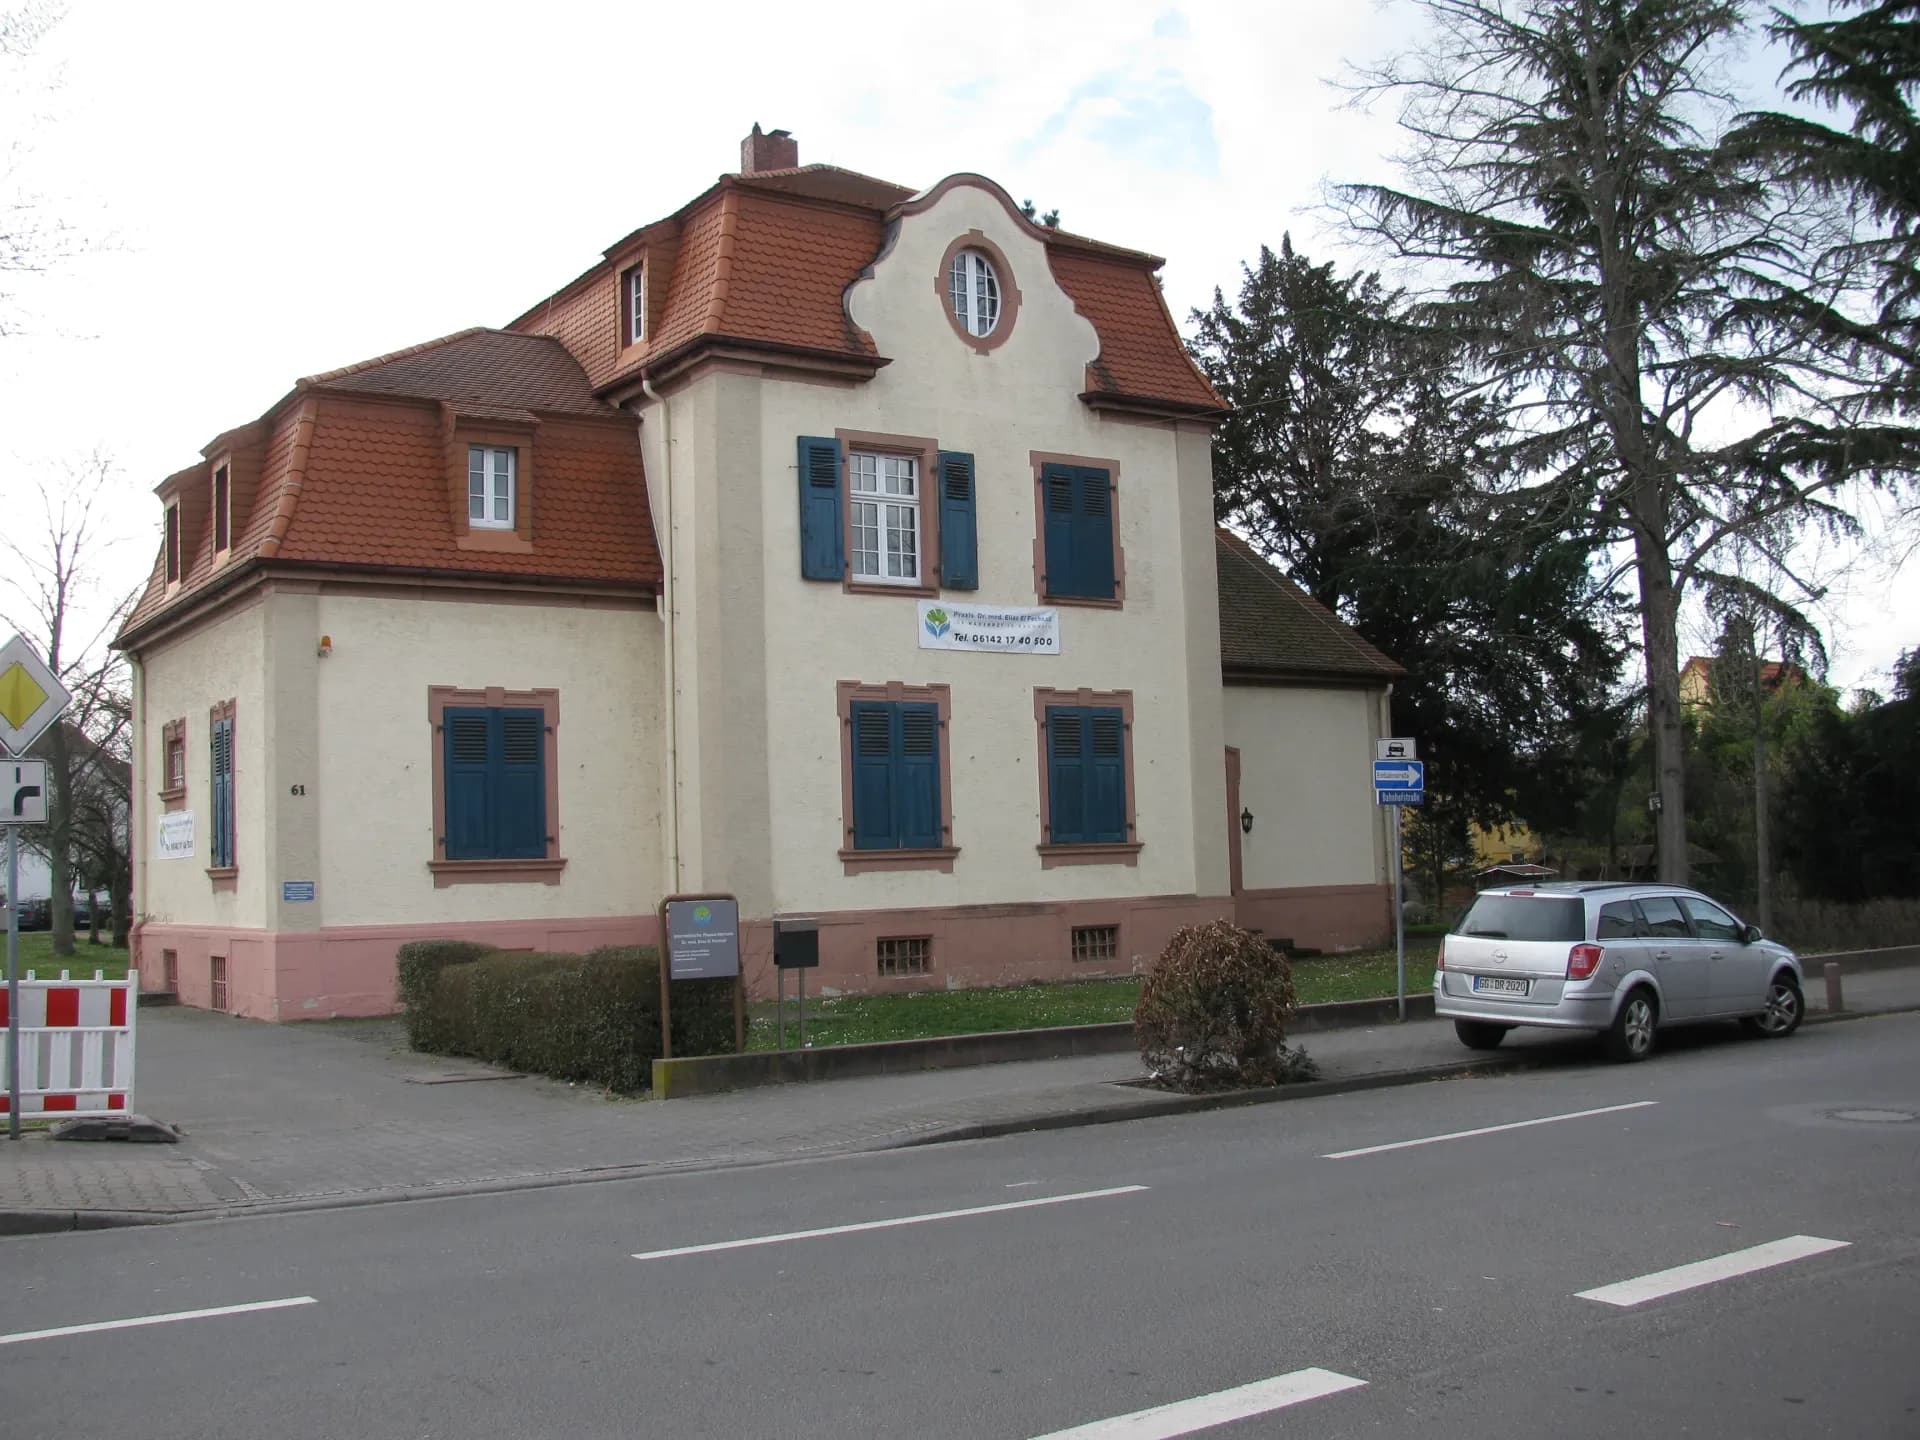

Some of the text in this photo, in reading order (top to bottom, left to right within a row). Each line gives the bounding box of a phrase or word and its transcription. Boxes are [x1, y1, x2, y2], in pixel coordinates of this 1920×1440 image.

[954, 633, 1052, 646] Tel. 06142 17 40 500
[291, 784, 306, 796] 61
[1382, 791, 1420, 802] Bahnhofstraße
[1505, 980, 1526, 991] 2020
